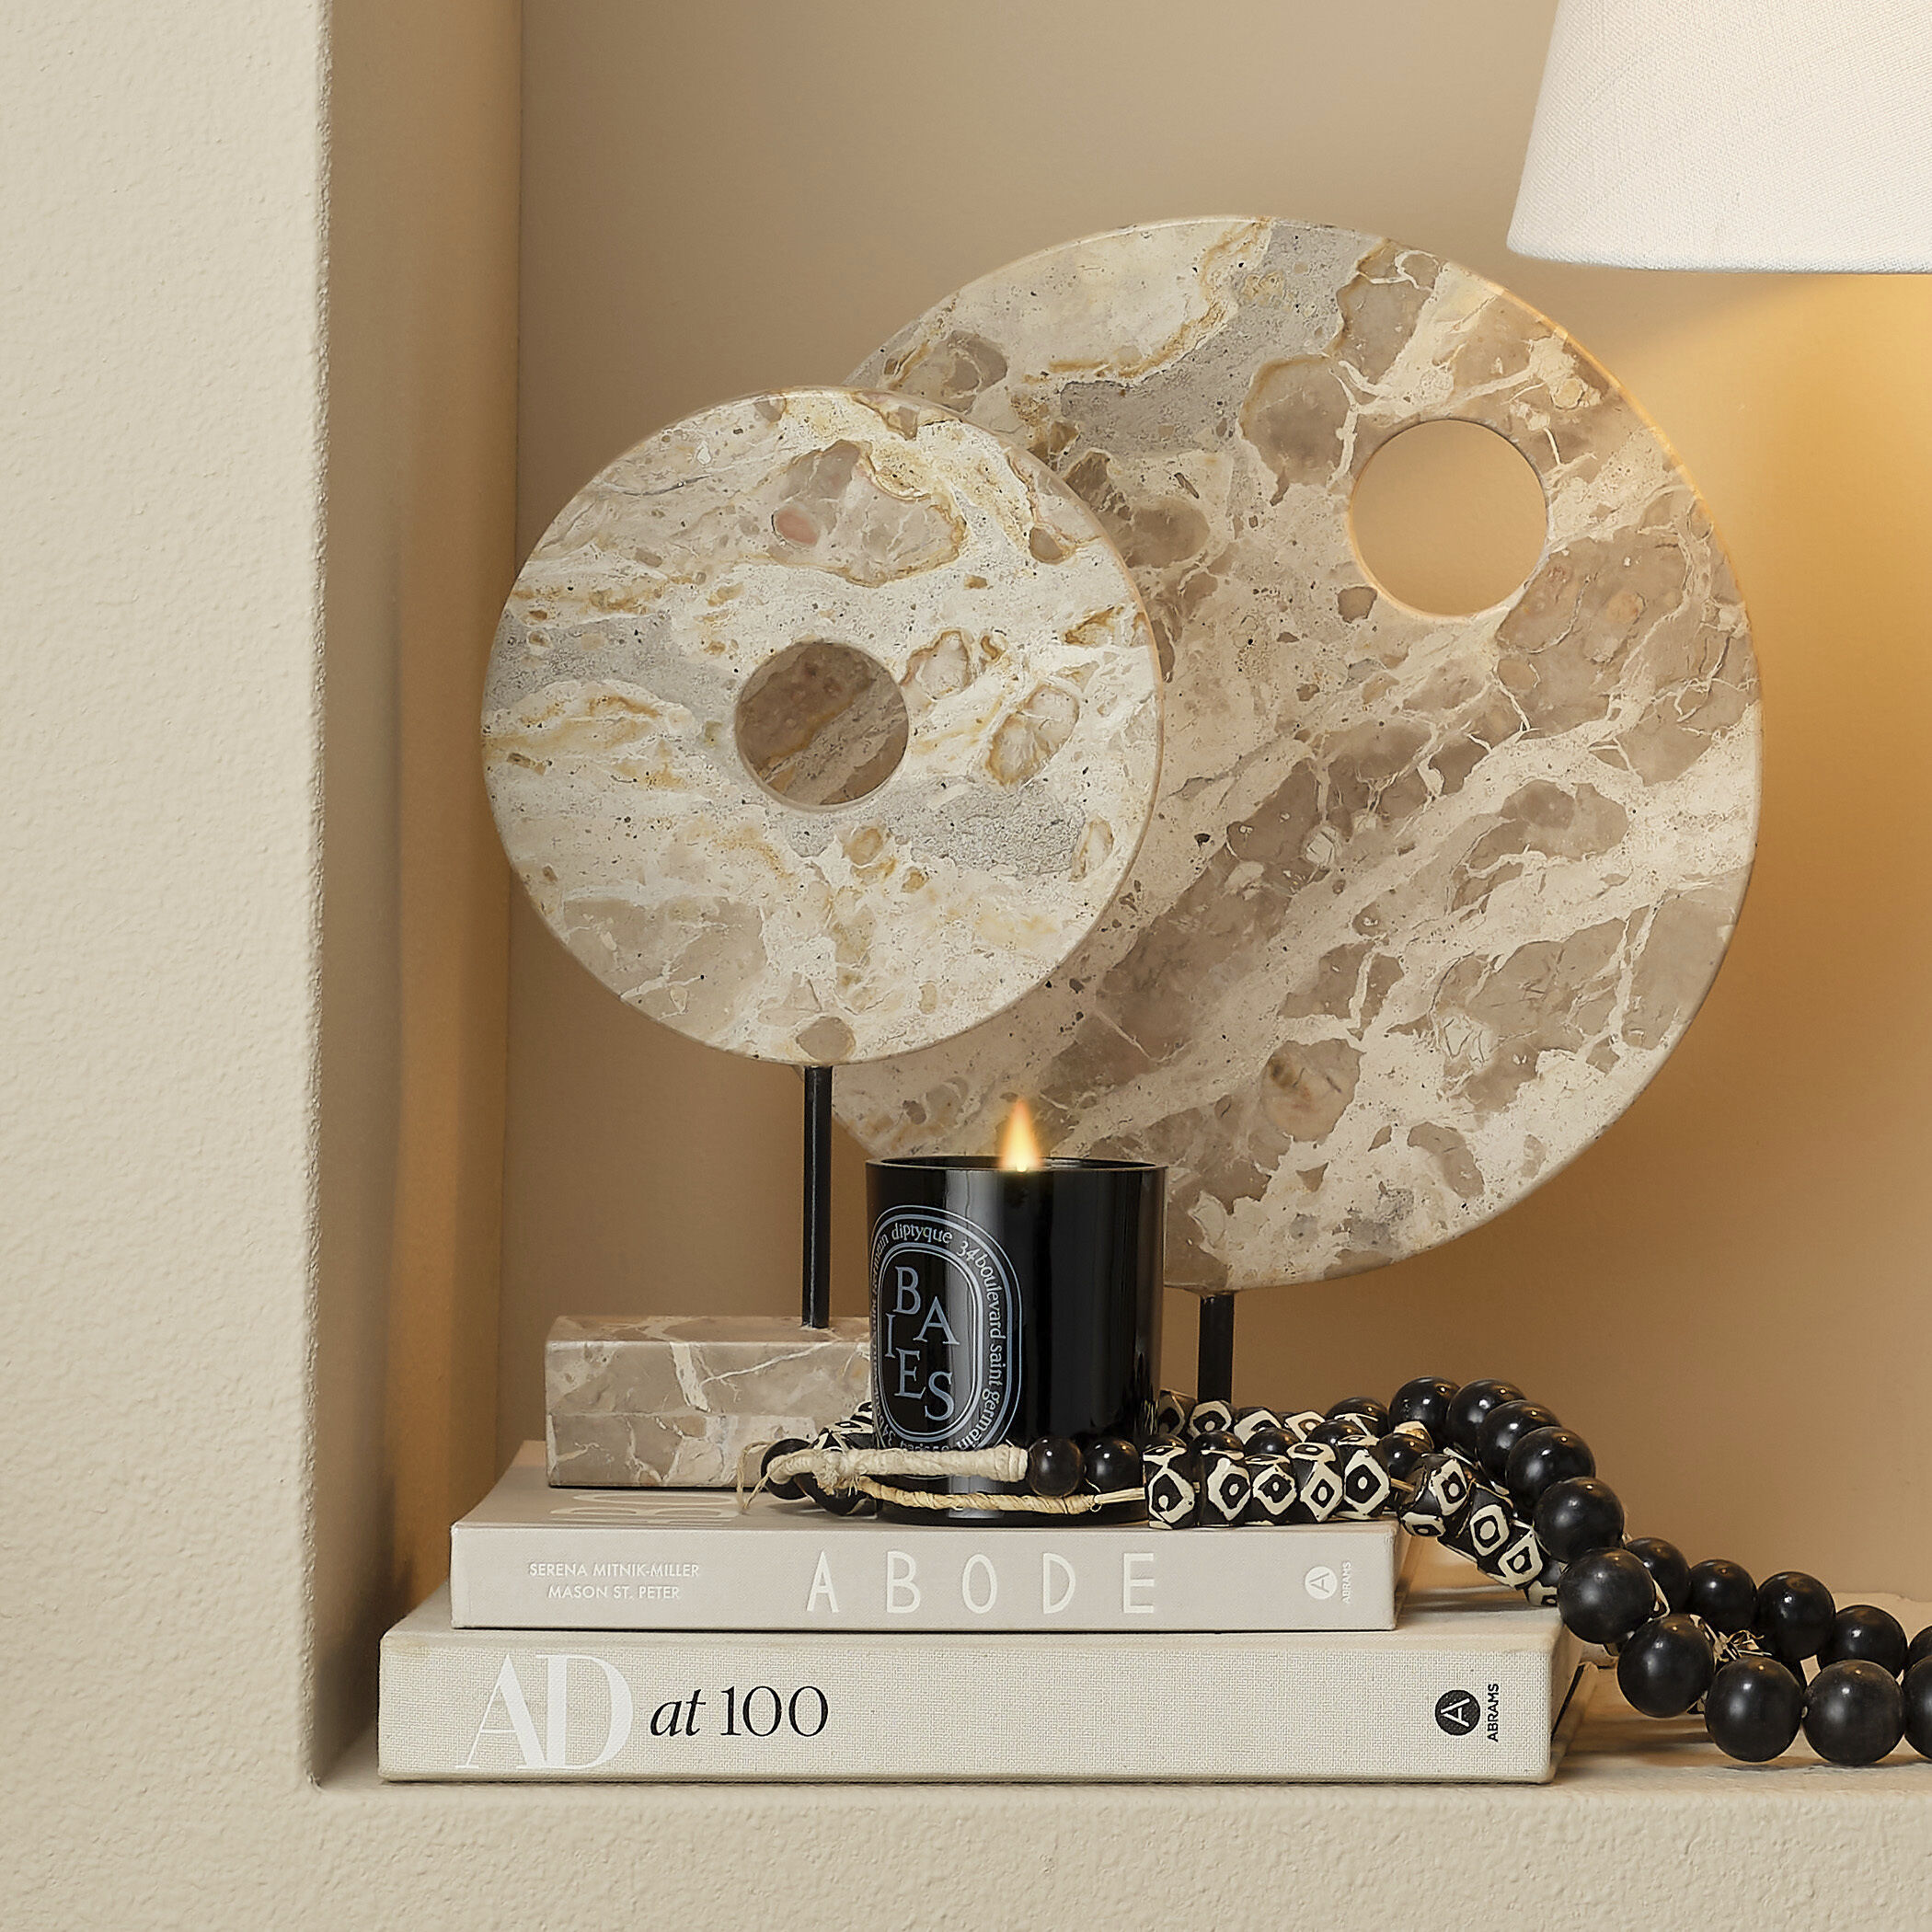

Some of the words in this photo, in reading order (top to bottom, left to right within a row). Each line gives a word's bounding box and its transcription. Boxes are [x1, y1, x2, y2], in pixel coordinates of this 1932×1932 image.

[891, 1222, 953, 1244] diptyque
[988, 1343, 1006, 1386] saint
[957, 1388, 1001, 1451] germain
[529, 1562, 588, 1578] SERENA
[592, 1563, 700, 1579] MITNIK-MILLER
[547, 1585, 609, 1600] MASON
[613, 1585, 634, 1600] ST.
[638, 1585, 681, 1600] PETER
[806, 1550, 1156, 1615] ABODE
[1340, 1560, 1352, 1604] ABRAMS
[454, 1653, 633, 1771] AD
[650, 1688, 707, 1737] at
[719, 1685, 829, 1738] 100
[1486, 1683, 1501, 1743] ABRAMS
